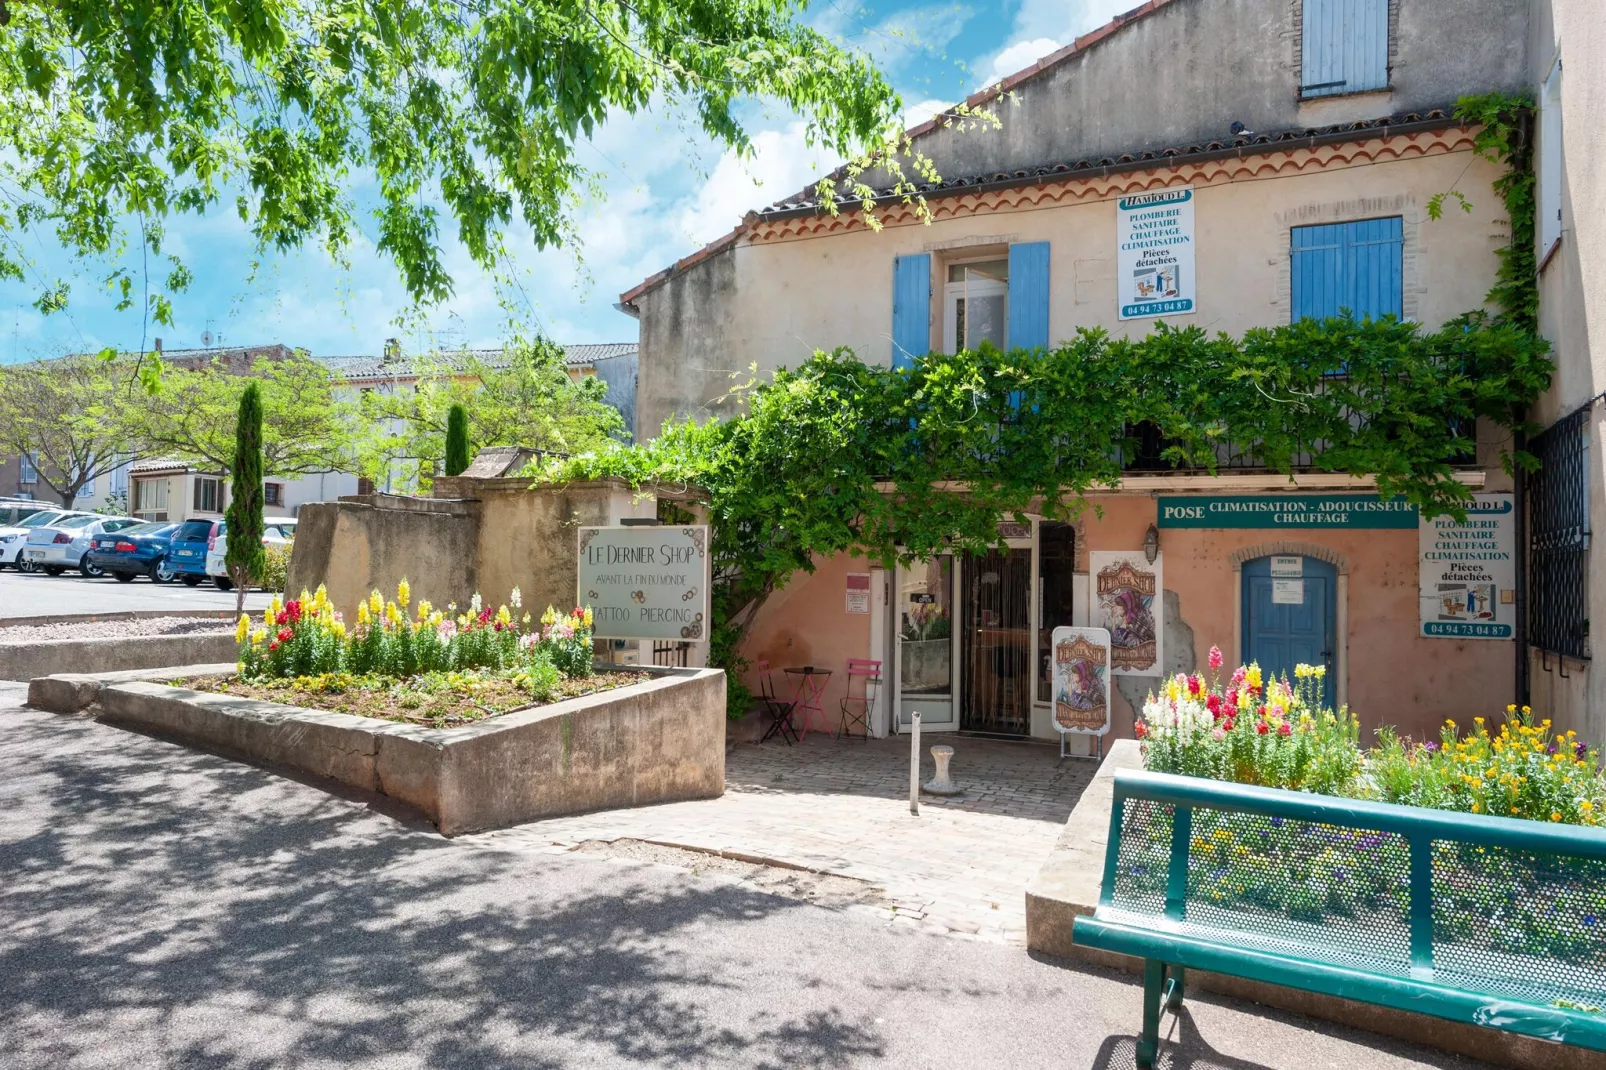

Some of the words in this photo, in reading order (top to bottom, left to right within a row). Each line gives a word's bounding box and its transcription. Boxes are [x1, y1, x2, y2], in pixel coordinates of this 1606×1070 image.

[1129, 208, 1182, 222] PLOMBERIE
[1132, 219, 1178, 231] SANITAIRE
[1130, 227, 1181, 241] CHAUFFAGE
[1121, 235, 1190, 251] CLIMATISATION
[1143, 249, 1170, 258] Pièces
[1136, 256, 1177, 268] détachées
[1128, 307, 1137, 315] 04
[1140, 305, 1150, 314] 94
[1153, 304, 1161, 312] 73
[1164, 302, 1174, 311] 04
[1177, 301, 1187, 310] 87
[1164, 506, 1205, 519] POSE
[1209, 502, 1307, 512] CLIMATISATION
[1318, 501, 1413, 512] ADOUCISSEUR
[1274, 513, 1349, 523] CHAUFFAGE
[1438, 531, 1495, 539] SANITAIRE
[1435, 541, 1499, 550] CHAUFFAGE
[588, 545, 604, 565] LE
[607, 544, 655, 565] DERNIER
[660, 544, 695, 566] SHOP
[1424, 552, 1509, 560] CLIMATISATION
[1450, 562, 1484, 572] Pièces
[596, 574, 622, 585] AVANT
[623, 574, 633, 585] LA
[635, 574, 647, 584] FIN
[648, 574, 659, 584] DU
[660, 574, 687, 586] MONDE
[1441, 572, 1493, 581] détachées
[592, 606, 630, 621] TATTOO
[640, 607, 691, 623] PIERCING
[1431, 624, 1443, 633] 04
[1446, 625, 1458, 634] 94
[1462, 625, 1473, 634] 73
[1476, 626, 1488, 635] 04
[1492, 626, 1504, 635] 87
